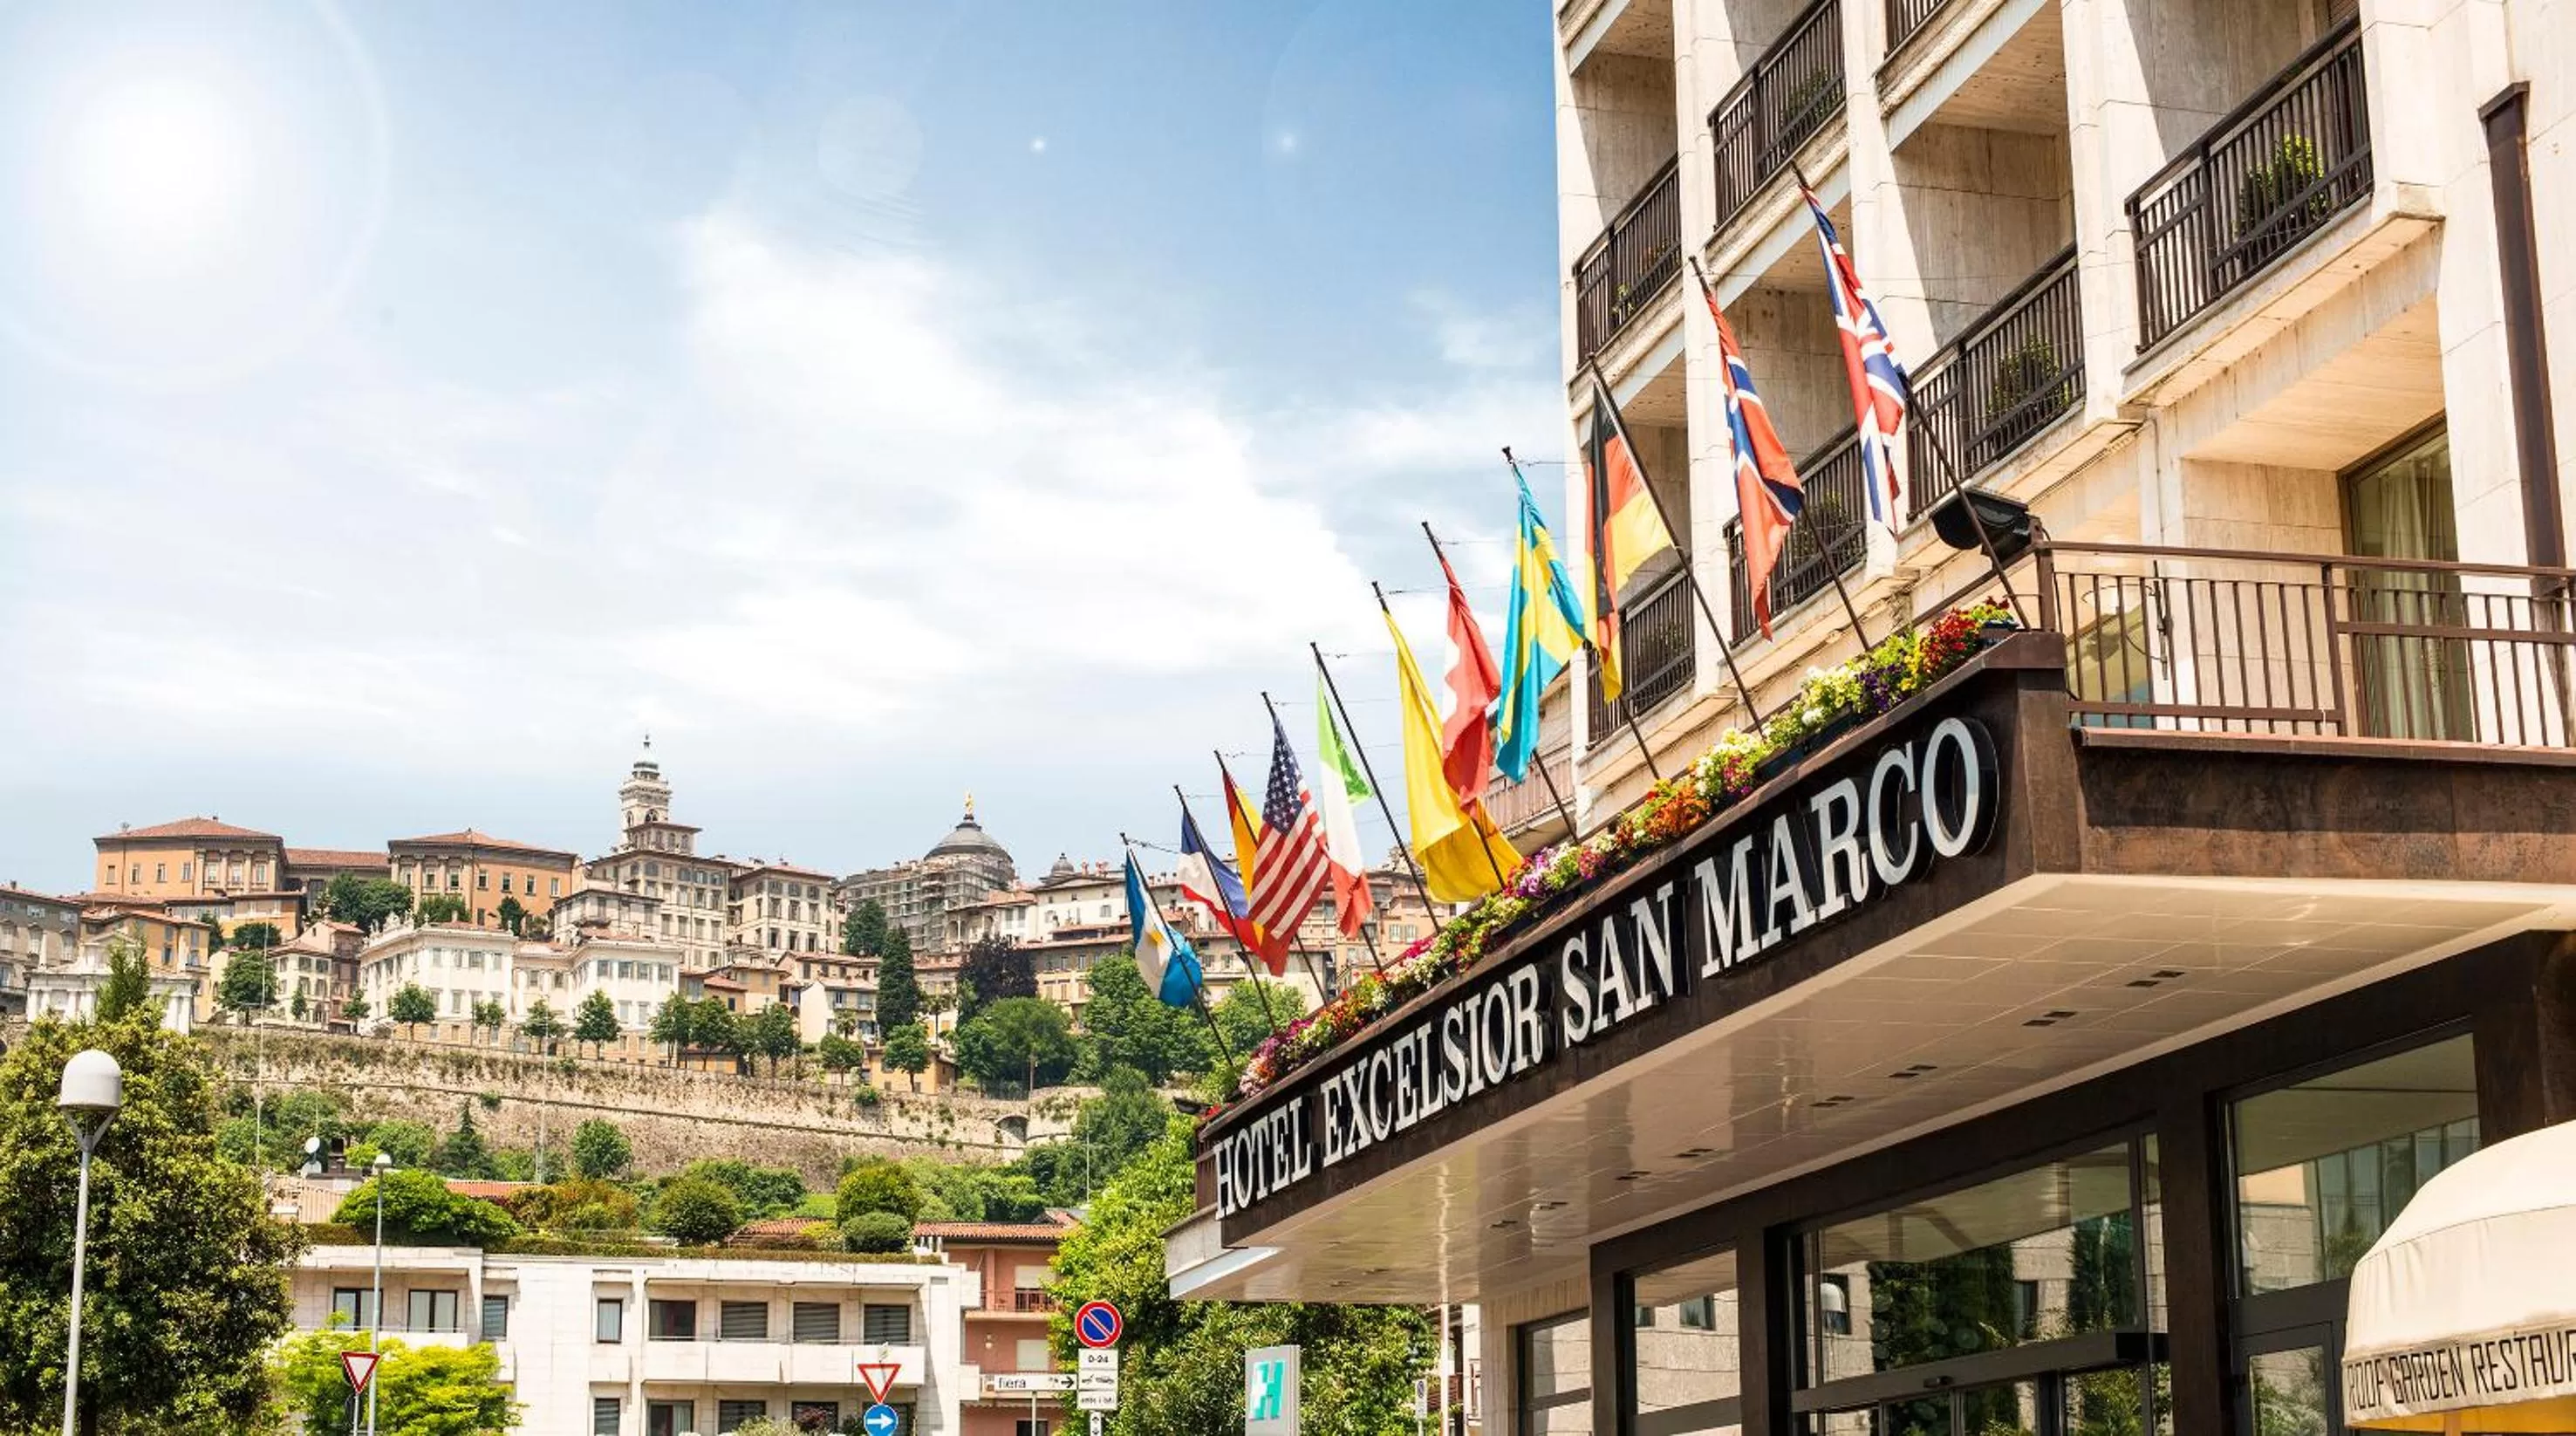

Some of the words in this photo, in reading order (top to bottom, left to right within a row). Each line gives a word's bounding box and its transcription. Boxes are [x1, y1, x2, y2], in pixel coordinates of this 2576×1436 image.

[1214, 1097, 1313, 1220] HOTEL
[1320, 962, 1543, 1168] EXCELSIOR
[1561, 879, 1675, 1047] SAN
[1694, 717, 1980, 979] MARCO
[2347, 1358, 2384, 1411] ROOF
[2388, 1343, 2467, 1405] GARDEN
